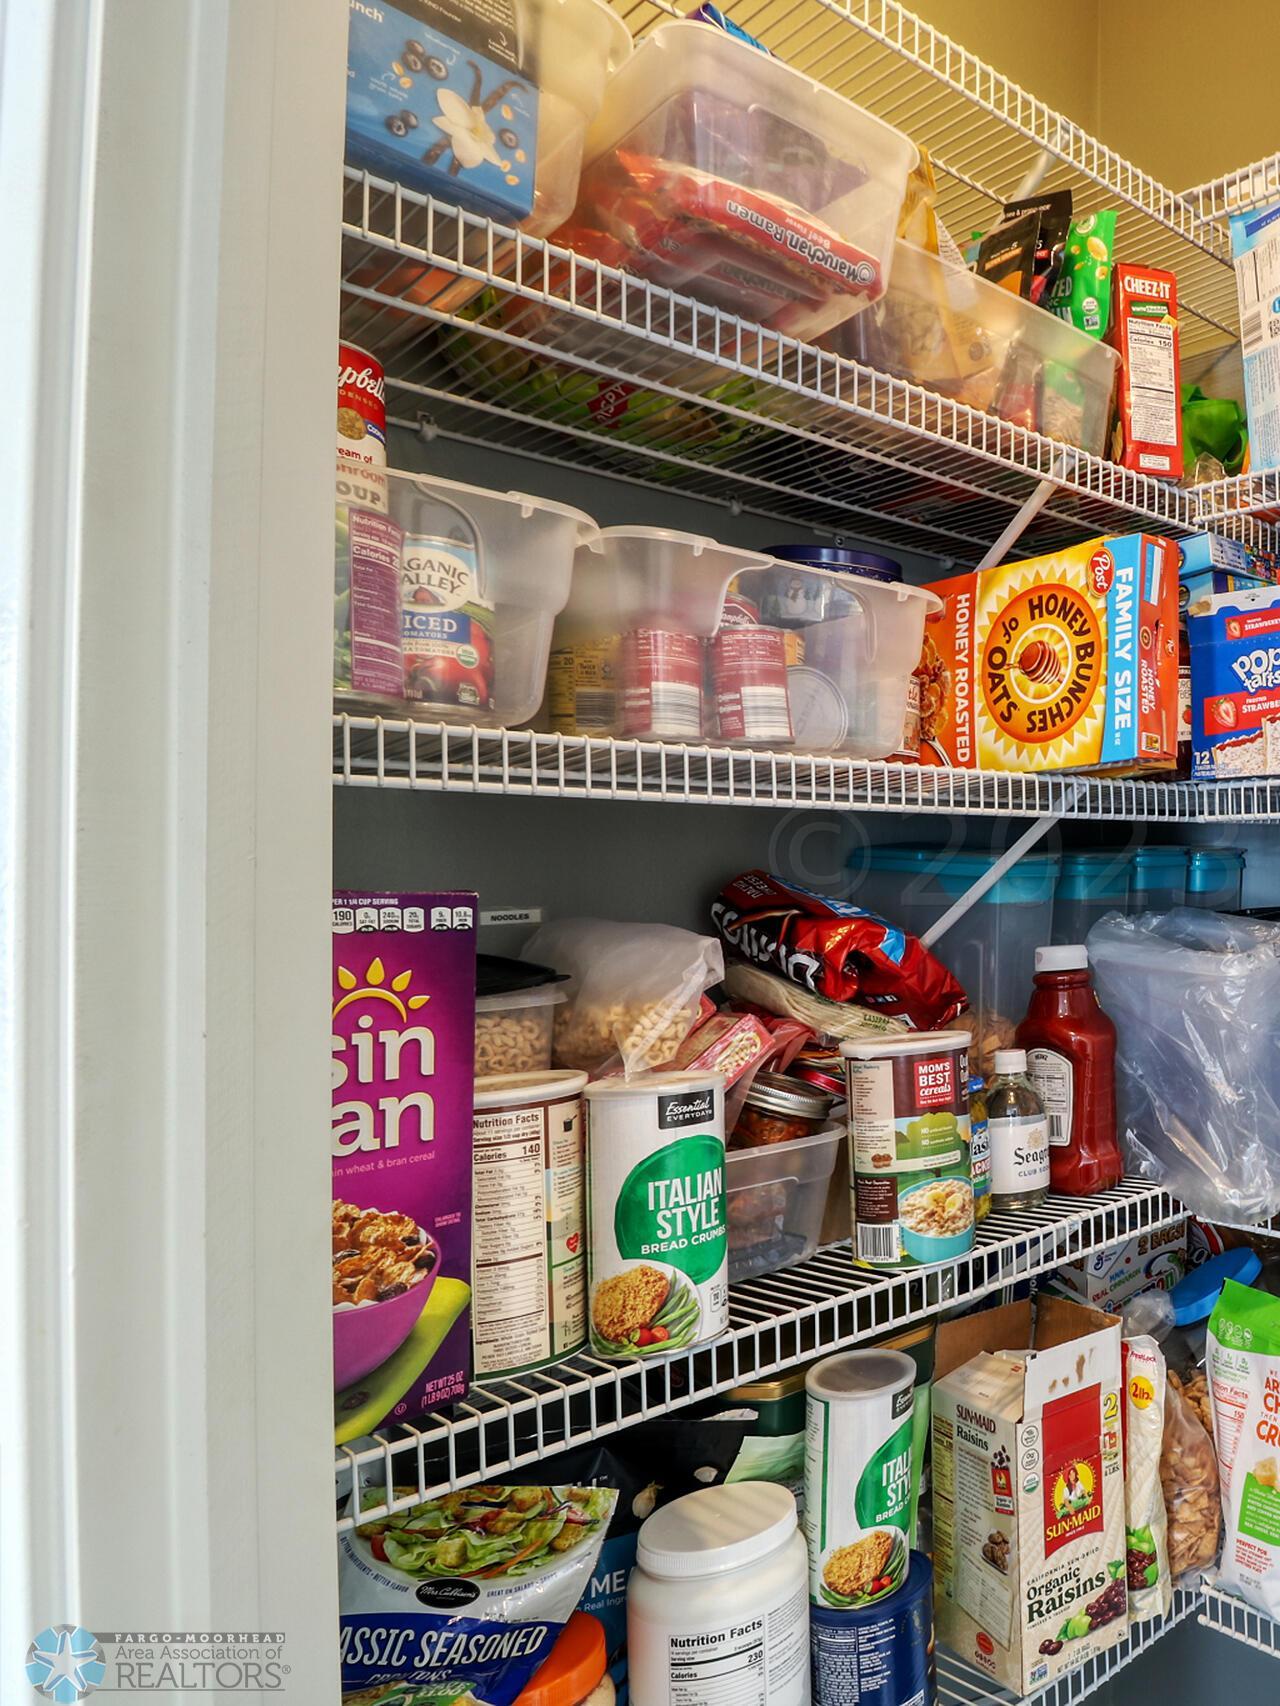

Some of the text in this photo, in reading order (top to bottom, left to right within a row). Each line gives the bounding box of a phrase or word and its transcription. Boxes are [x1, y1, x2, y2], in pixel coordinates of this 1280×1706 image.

[728, 199, 784, 241] Ramen
[1159, 339, 1172, 348] 150
[363, 455, 373, 465] of
[352, 515, 387, 533] Nutrition
[352, 546, 391, 564] Calories
[1094, 553, 1109, 591] Post
[404, 615, 457, 633] ICED
[1028, 593, 1091, 637] HONEY
[1115, 567, 1134, 729] FAMILY SIZE
[956, 592, 970, 763] HONEY ROASTED
[987, 646, 1020, 723] OATS
[1026, 640, 1095, 734] BUNCHES
[1147, 669, 1156, 710] HONEY
[1193, 752, 1209, 764] 12
[333, 911, 352, 921] 190
[490, 912, 530, 922] NOODLES
[919, 1062, 950, 1074] MOM'S
[919, 1072, 951, 1086] BEST
[920, 1084, 951, 1096] cereals
[666, 1097, 710, 1116] Essential
[667, 1109, 712, 1122] EVERYDAY
[473, 1113, 539, 1128] Nutrition Facts
[474, 1143, 540, 1162] Calories 140
[346, 1151, 436, 1176] wheat & bran cereal
[1018, 1169, 1036, 1177] CLUB
[648, 1167, 722, 1211] ITALIAN
[657, 1198, 720, 1240] STYLE
[641, 1226, 726, 1255] BREAD CRUMBS
[1138, 1235, 1149, 1255] 2
[1103, 1392, 1119, 1420] 2
[1234, 1410, 1245, 1419] 150
[957, 1426, 989, 1452] Raisins
[876, 1503, 903, 1522] BREAD
[372, 1572, 390, 1587] BETTER
[390, 1580, 409, 1593] FLAVOR
[1027, 1564, 1065, 1587] CALIFORNIA
[1027, 1566, 1081, 1601] Organic
[1027, 1571, 1106, 1624] Raisins
[671, 1619, 762, 1648] Nutrition Facts
[414, 1626, 548, 1669] SEASONED
[747, 1650, 763, 1663] 230
